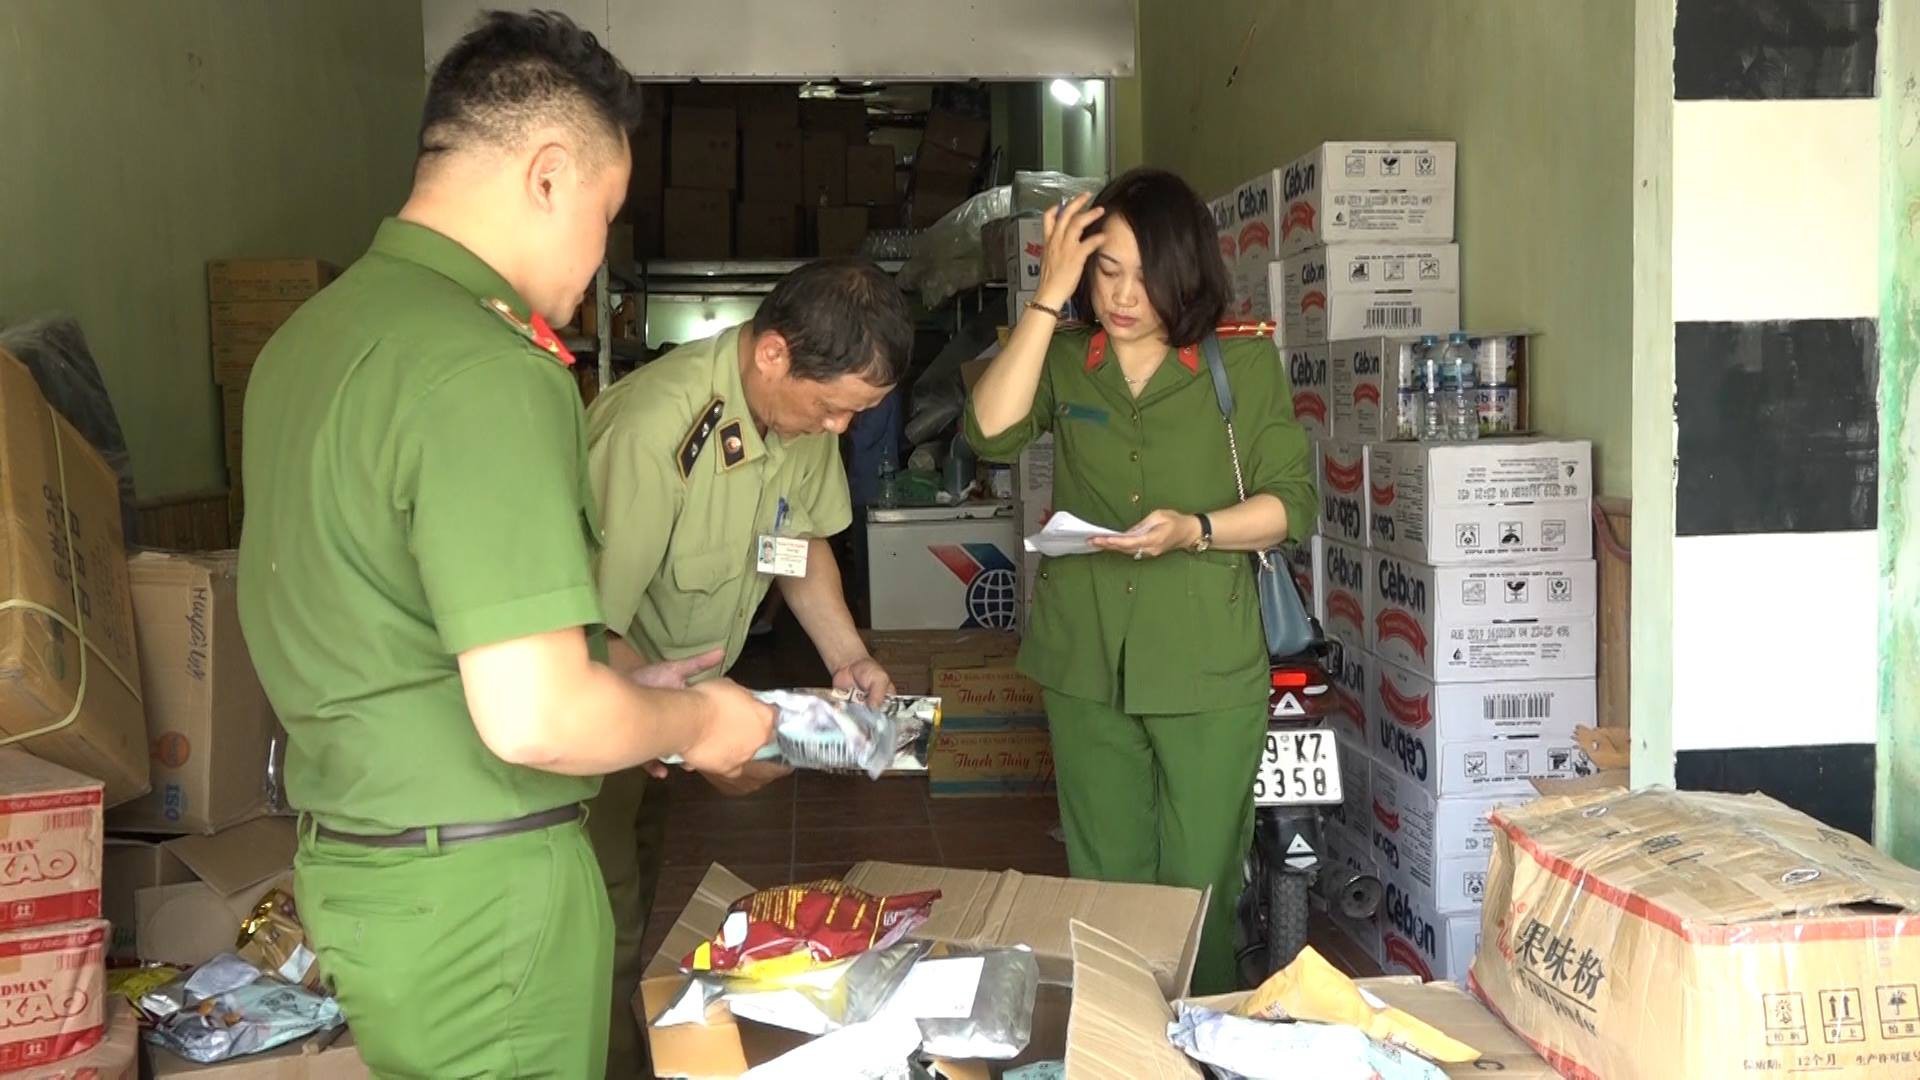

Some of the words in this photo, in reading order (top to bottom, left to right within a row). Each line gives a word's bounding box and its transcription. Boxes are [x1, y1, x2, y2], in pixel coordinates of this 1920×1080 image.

[0, 838, 35, 855] MAN
[0, 848, 78, 887] KAO
[1515, 918, 1606, 1000] 果味粉
[1, 979, 47, 997] DMAN
[0, 988, 89, 1030] KAO
